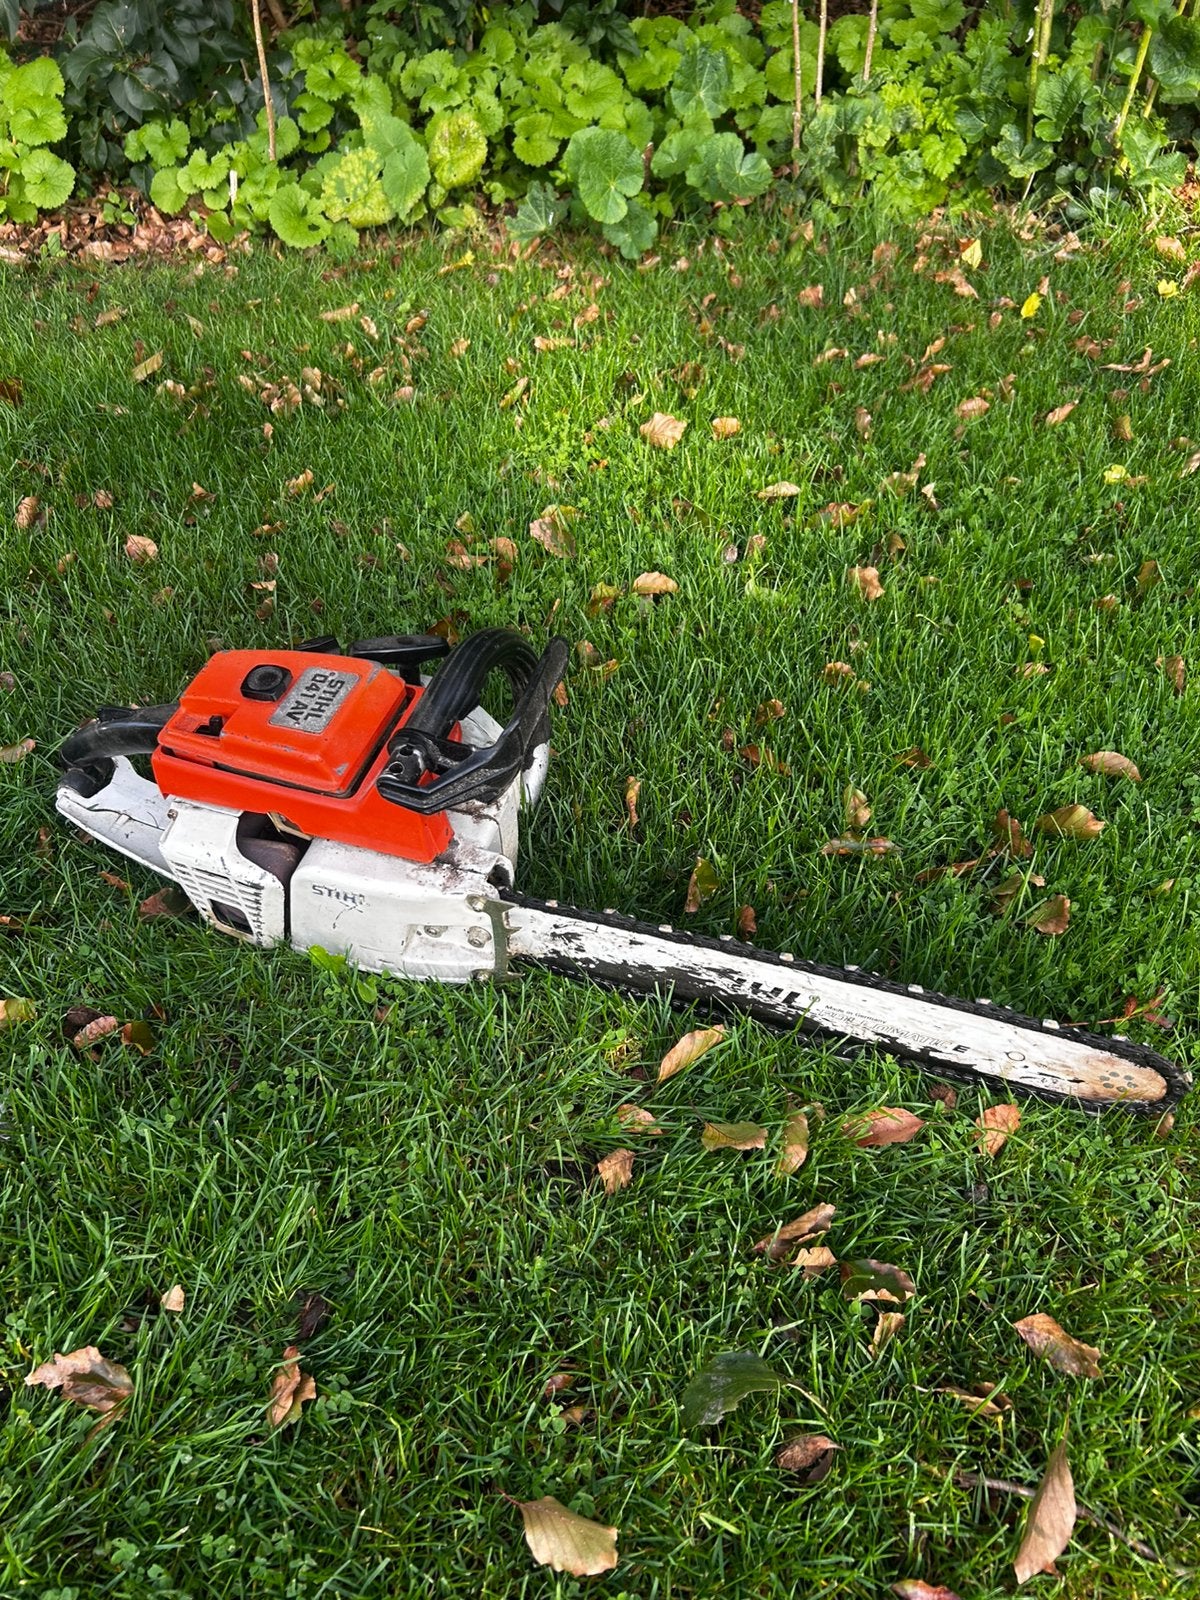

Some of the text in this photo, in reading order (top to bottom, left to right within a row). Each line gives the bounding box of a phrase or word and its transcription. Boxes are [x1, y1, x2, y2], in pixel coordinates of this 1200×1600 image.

[286, 673, 329, 722] 041 AV
[304, 679, 345, 720] STIHL
[825, 1004, 845, 1013] Made
[854, 1011, 887, 1025] Germany
[952, 1044, 971, 1054] E
